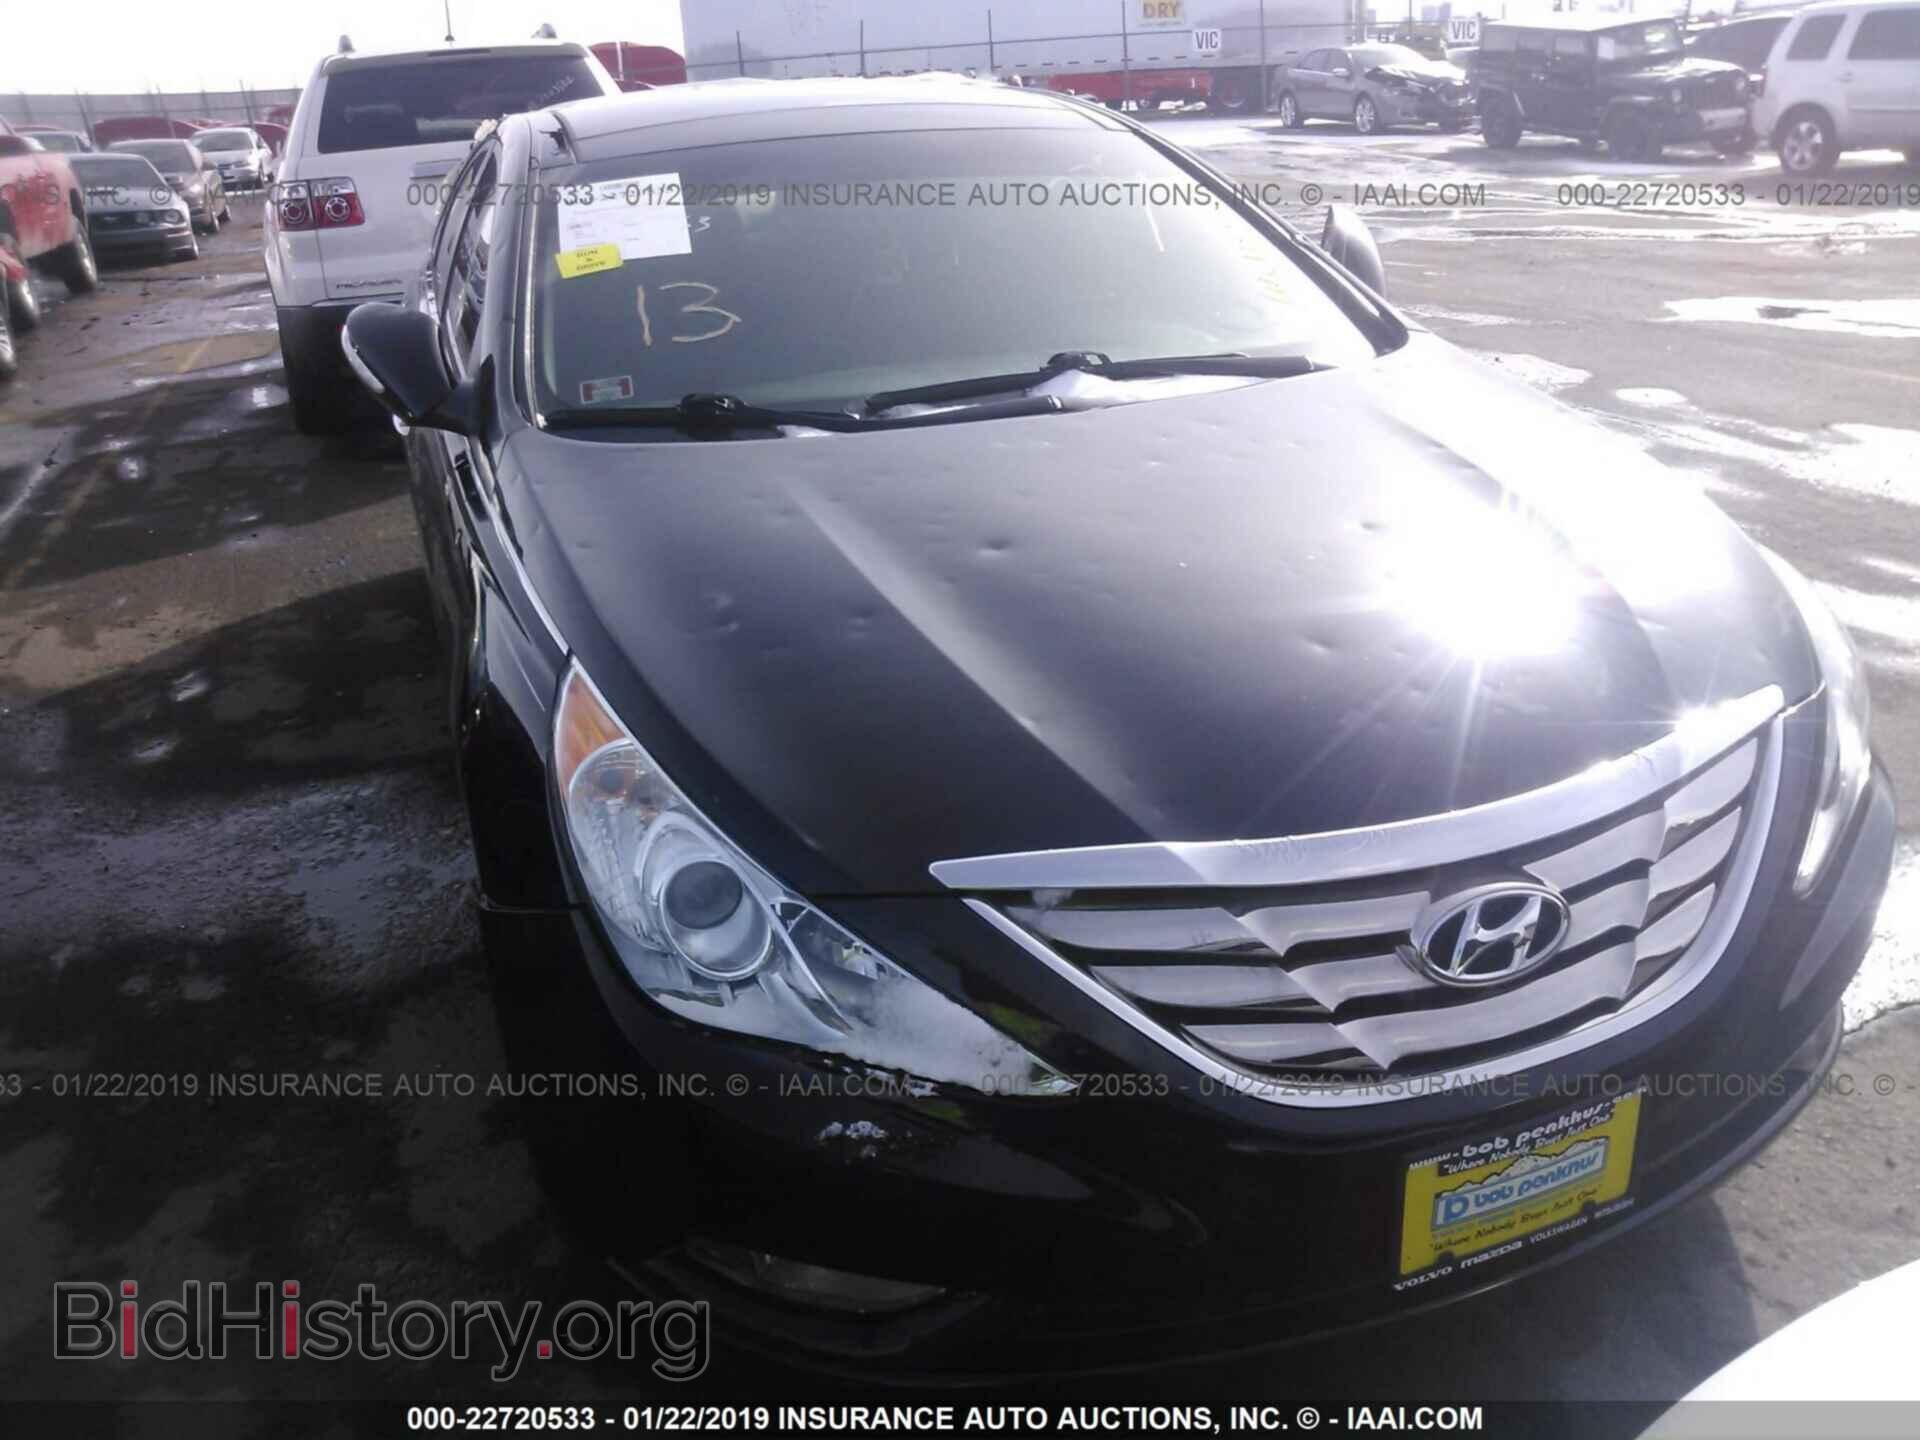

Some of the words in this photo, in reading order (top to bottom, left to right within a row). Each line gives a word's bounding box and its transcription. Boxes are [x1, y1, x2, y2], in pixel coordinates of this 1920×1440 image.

[1143, 2, 1177, 19] DRY
[1195, 31, 1219, 50] VIC
[1452, 20, 1476, 40] VIC
[637, 282, 743, 347] 13
[1474, 1185, 1514, 1208] bob
[1394, 1265, 1453, 1291] VOLVO
